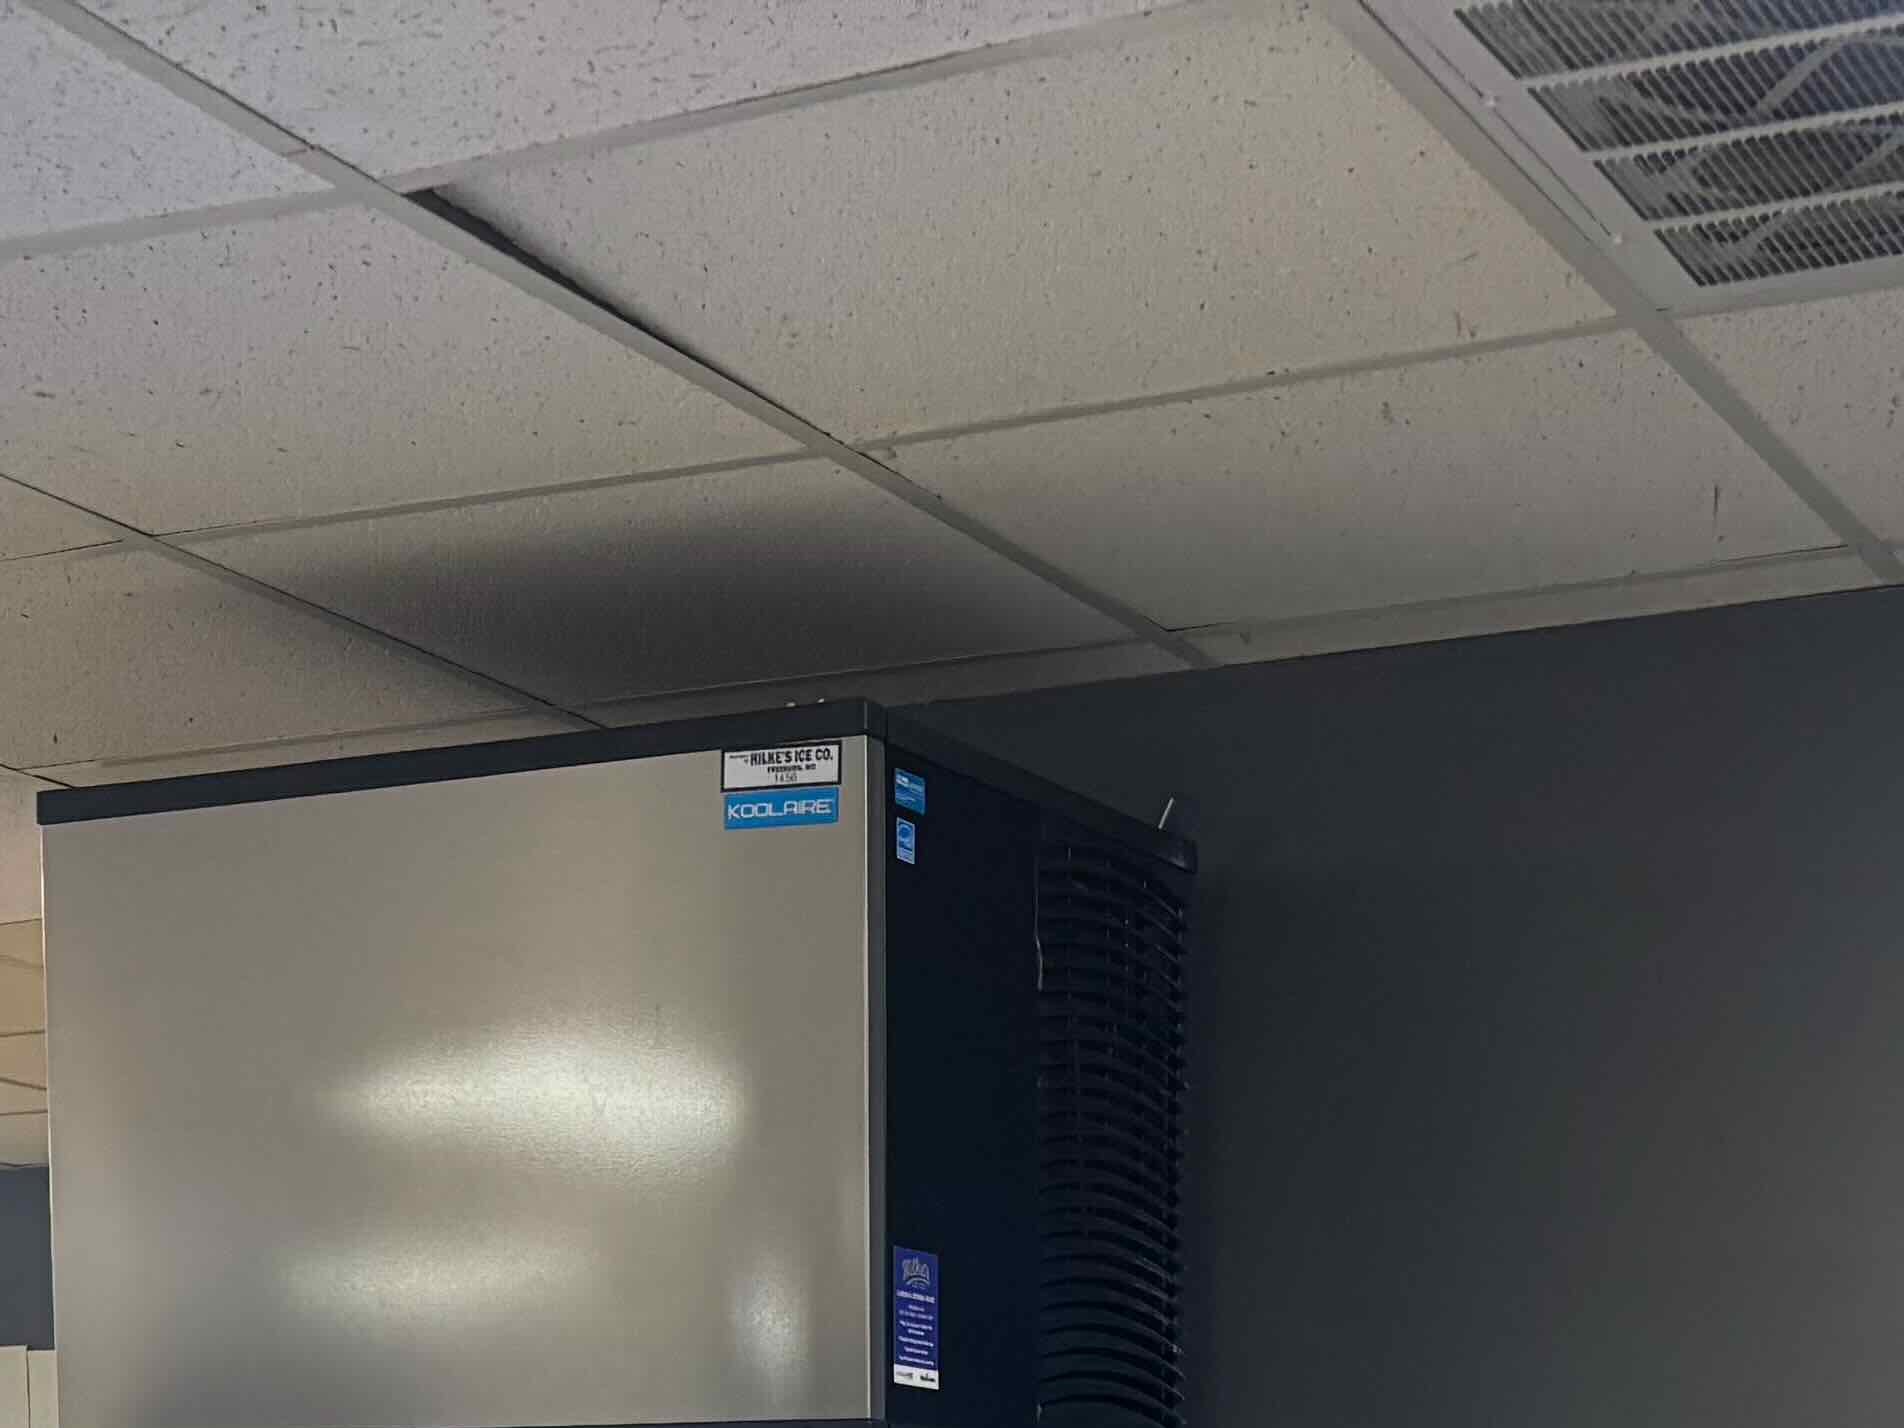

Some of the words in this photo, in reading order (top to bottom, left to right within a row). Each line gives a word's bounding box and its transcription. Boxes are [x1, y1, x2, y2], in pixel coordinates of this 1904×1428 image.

[795, 749, 812, 762] ICE
[816, 748, 834, 760] CO.
[728, 799, 833, 820] KOOLAIRE
